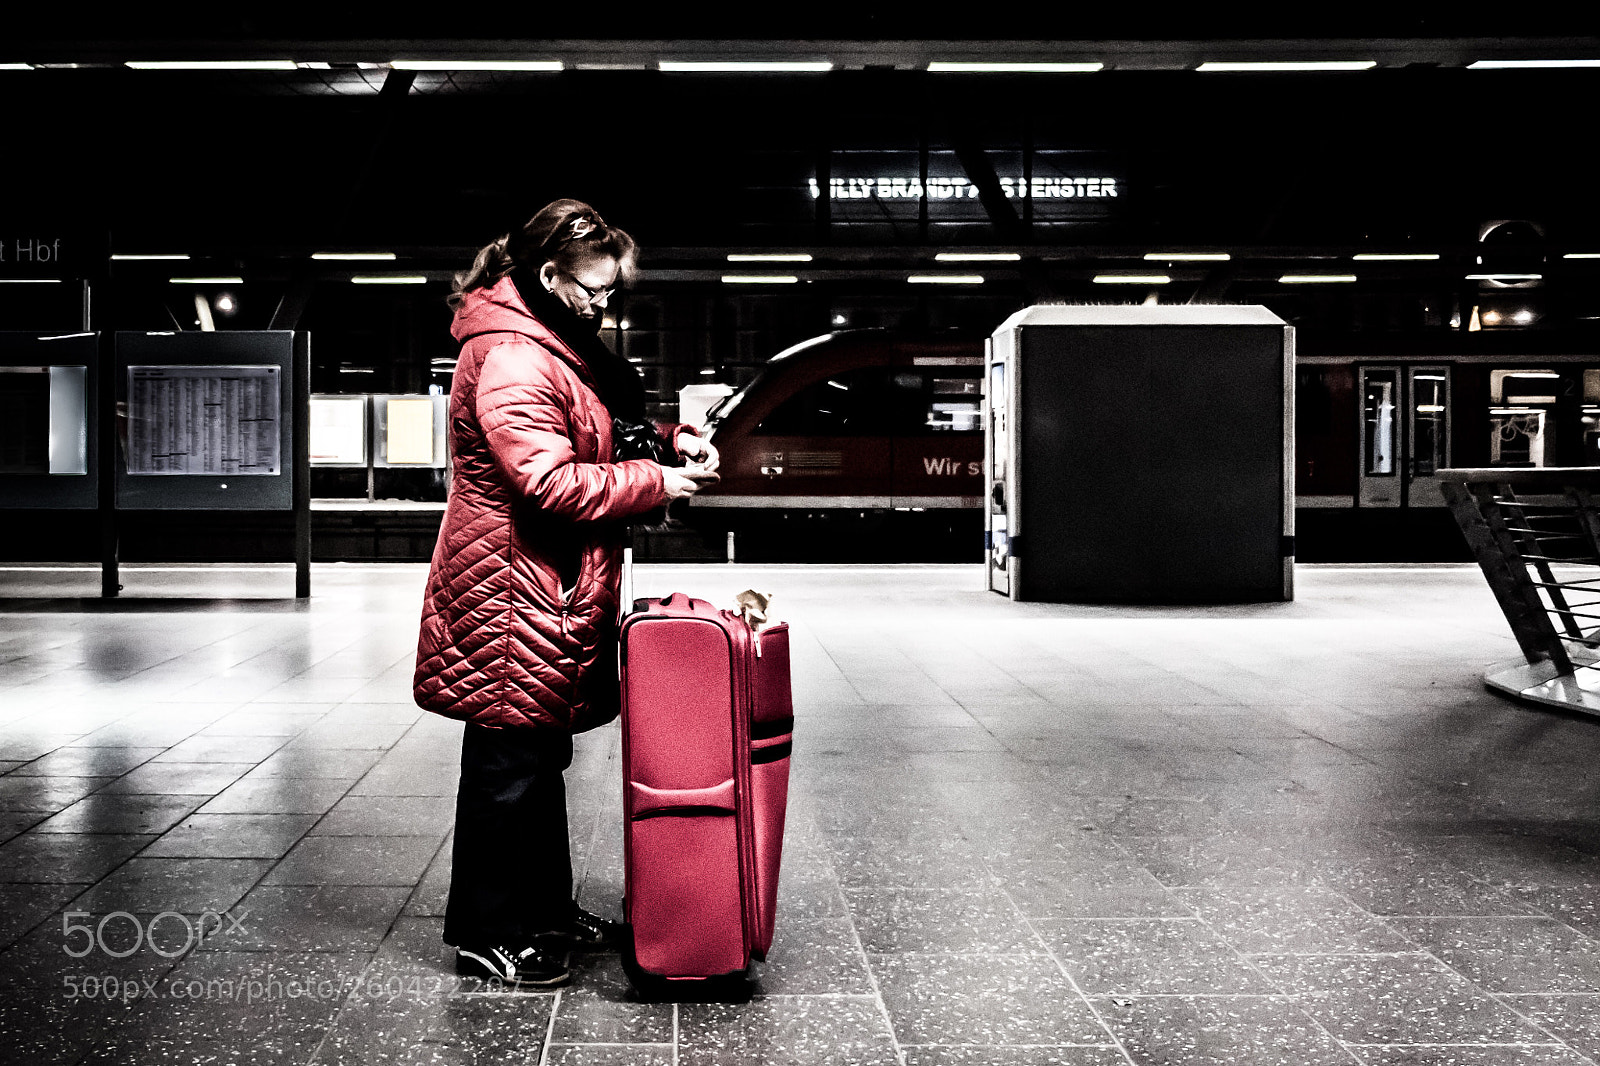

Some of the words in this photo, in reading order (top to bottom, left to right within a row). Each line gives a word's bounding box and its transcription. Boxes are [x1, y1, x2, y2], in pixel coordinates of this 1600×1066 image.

[877, 177, 967, 198] BRANDT
[16, 239, 60, 262] Hbf
[923, 457, 961, 475] Wir
